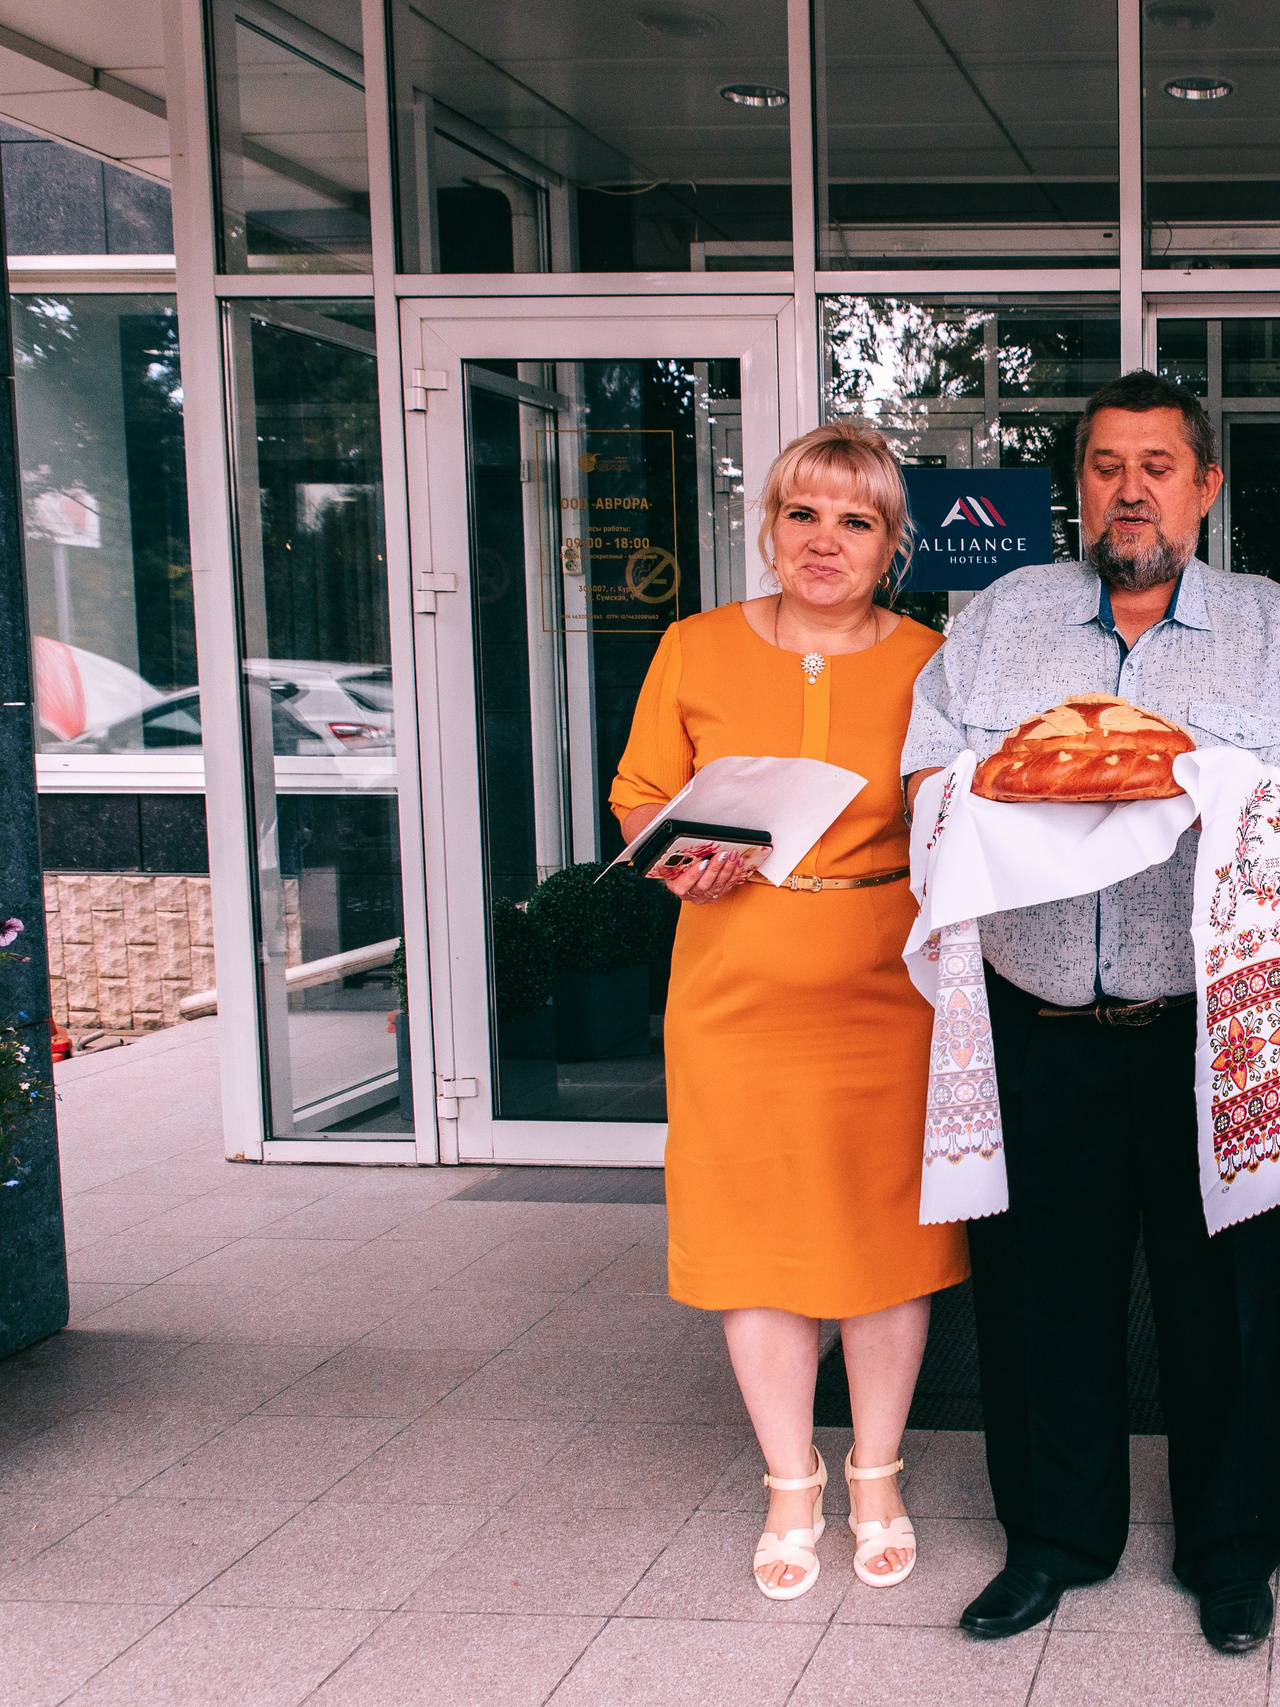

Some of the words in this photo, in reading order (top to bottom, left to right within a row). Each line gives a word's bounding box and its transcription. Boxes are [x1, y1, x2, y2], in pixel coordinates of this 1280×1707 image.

[614, 537, 650, 549] 18:00
[918, 537, 1027, 552] ALLIANCE
[949, 555, 998, 564] HOTELS
